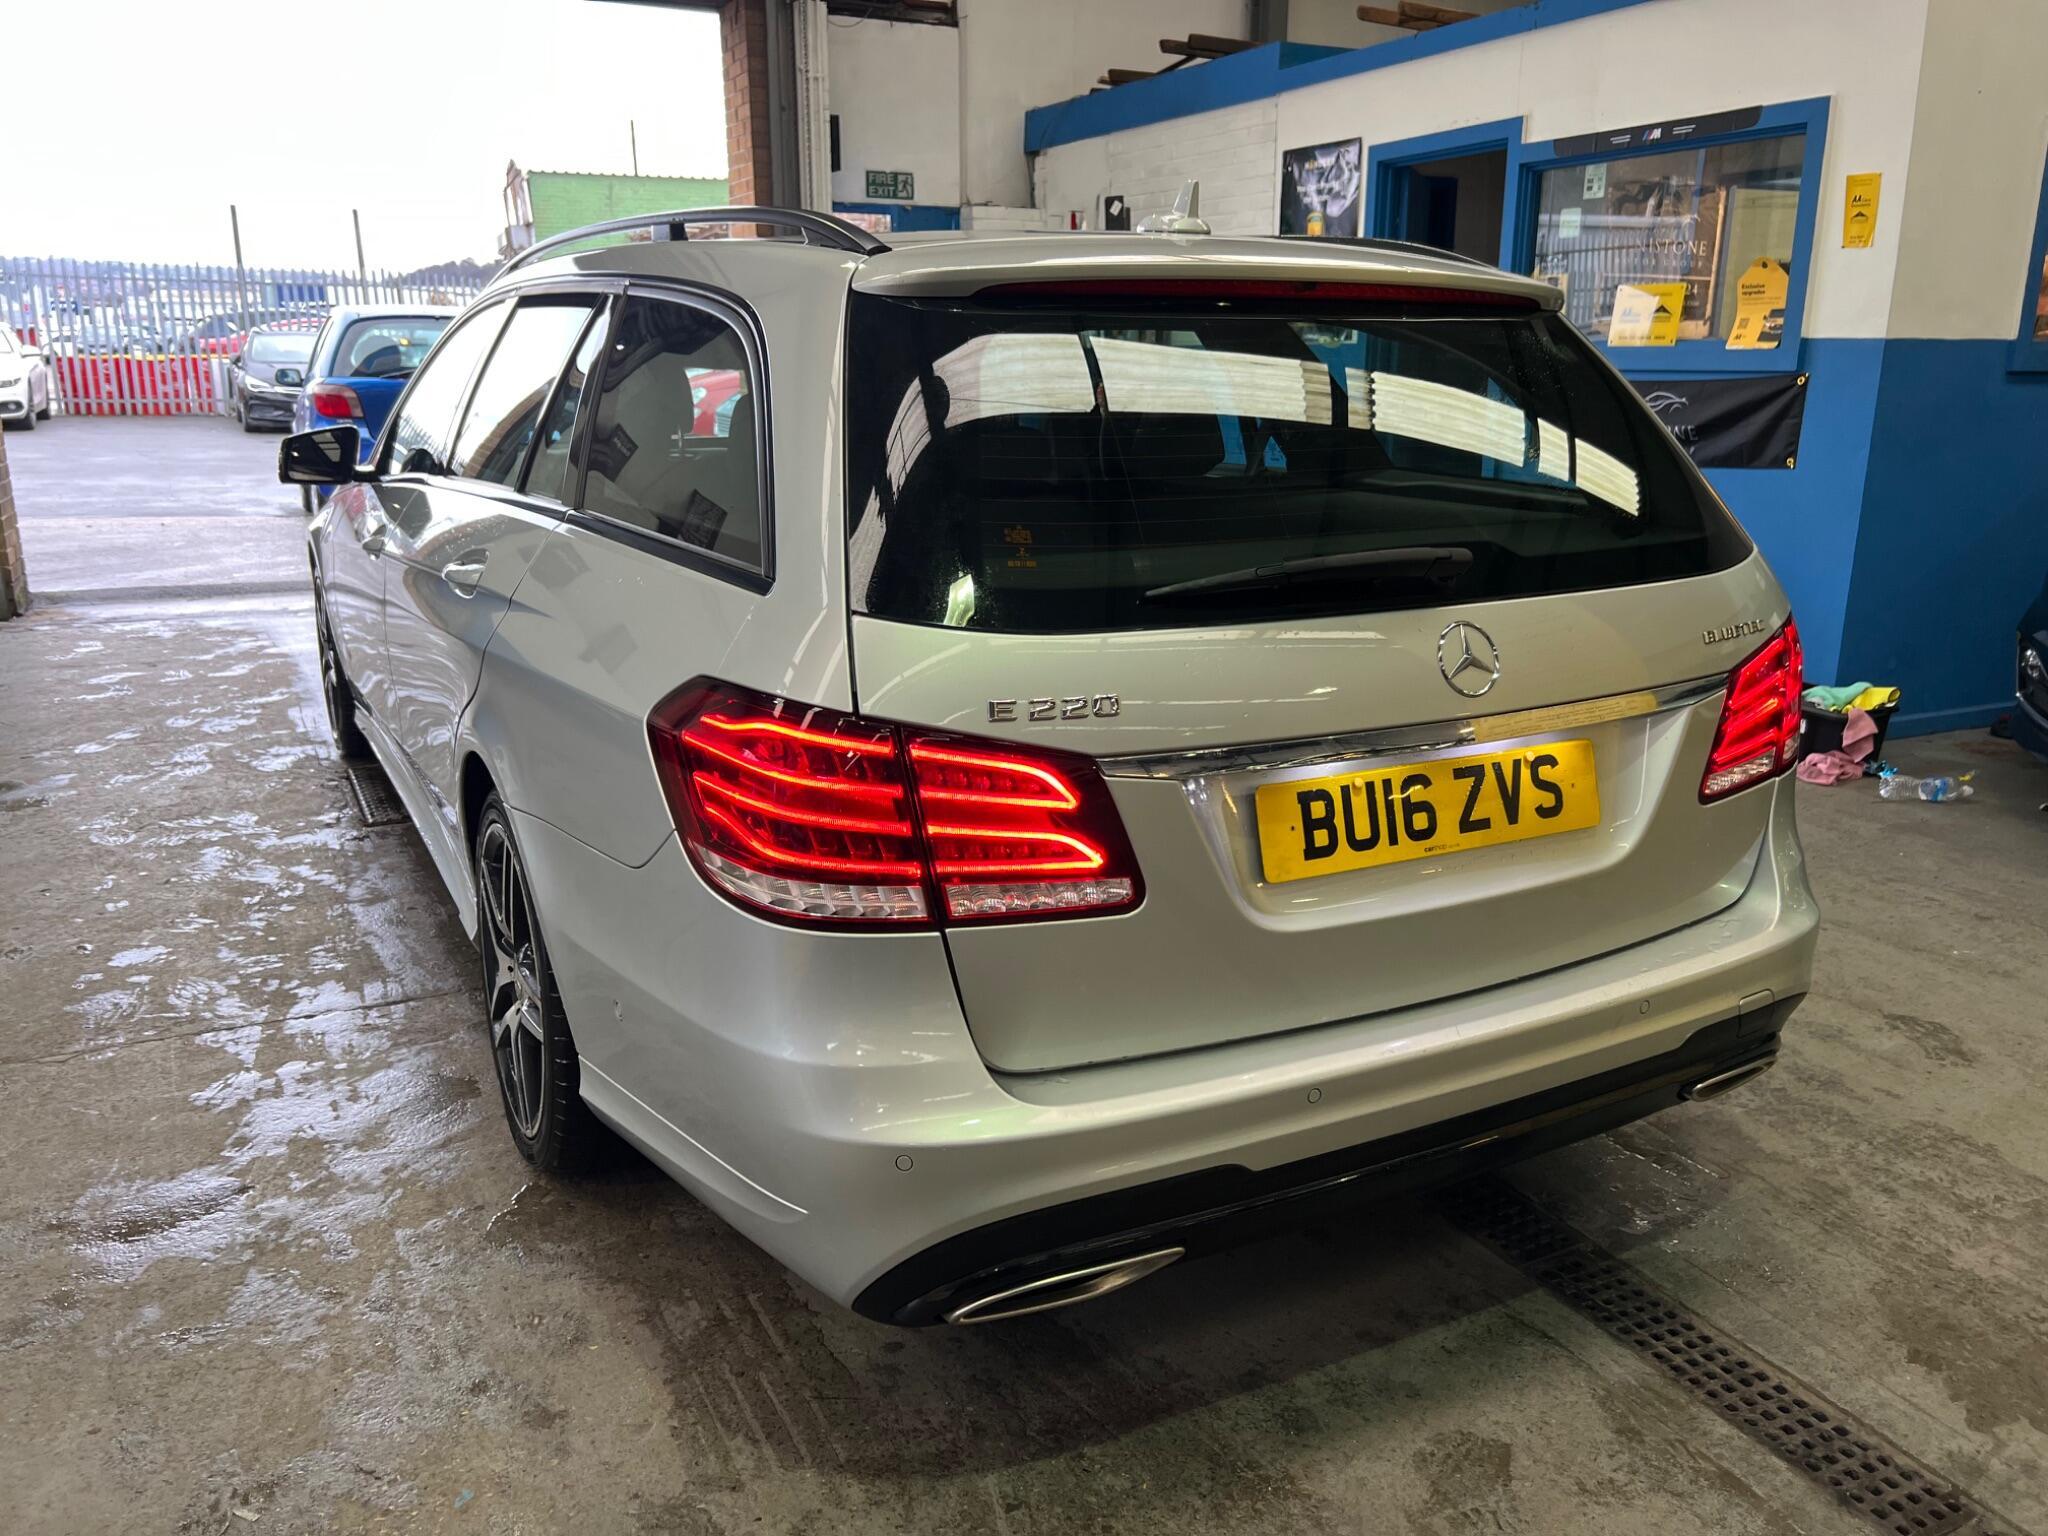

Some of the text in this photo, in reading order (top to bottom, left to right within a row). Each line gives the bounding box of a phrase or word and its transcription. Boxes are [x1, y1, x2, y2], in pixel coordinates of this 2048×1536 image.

[869, 172, 895, 185] FIRE
[869, 186, 895, 197] EXIT
[1703, 619, 1765, 644] BLUETEC
[988, 693, 1121, 722] E 220
[1297, 754, 1563, 861] BU16 ZVS
